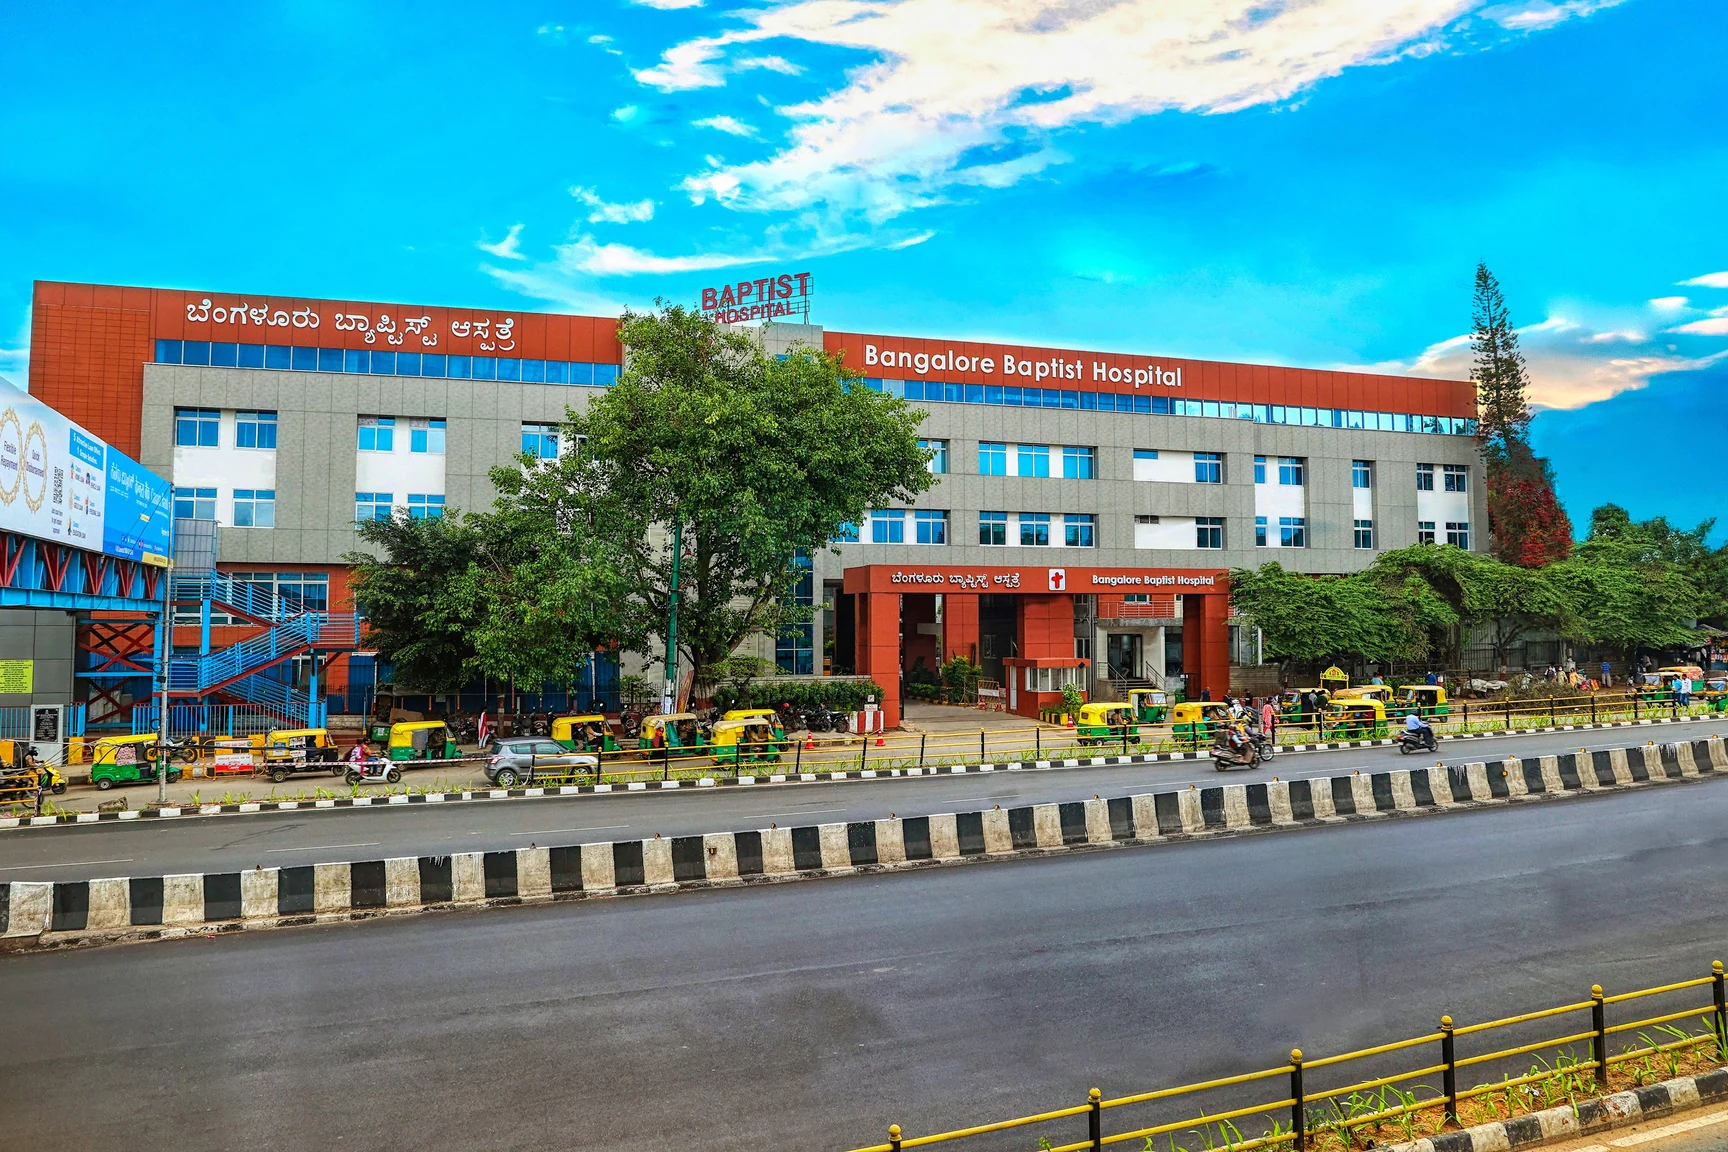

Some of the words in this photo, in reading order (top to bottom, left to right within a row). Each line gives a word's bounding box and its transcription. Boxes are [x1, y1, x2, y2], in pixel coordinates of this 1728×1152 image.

[702, 272, 810, 310] BAPTIST
[186, 298, 320, 329] ಬೆಂಗಳೂರು
[334, 313, 438, 346] ಬ್ಯಾಪ್ಟಿಸ್ಟ್
[451, 317, 516, 351] ಆಸ್ಪತ್ರೆ
[715, 300, 796, 324] HOSPITAL
[865, 344, 995, 375] Bangalore
[1003, 354, 1083, 382] Baptist
[1092, 361, 1182, 388] Hospital
[891, 571, 945, 584] ಬೆಂಗಳೂರು
[948, 573, 989, 588] ಬ್ಯಾಪ್ಟಿಸ್ಟ್
[993, 573, 1021, 588] ಆಸ್ಪತ್ರೆ
[1092, 574, 1142, 586] Bangalore
[1144, 575, 1175, 586] Baptist
[1177, 576, 1214, 586] Hospital
